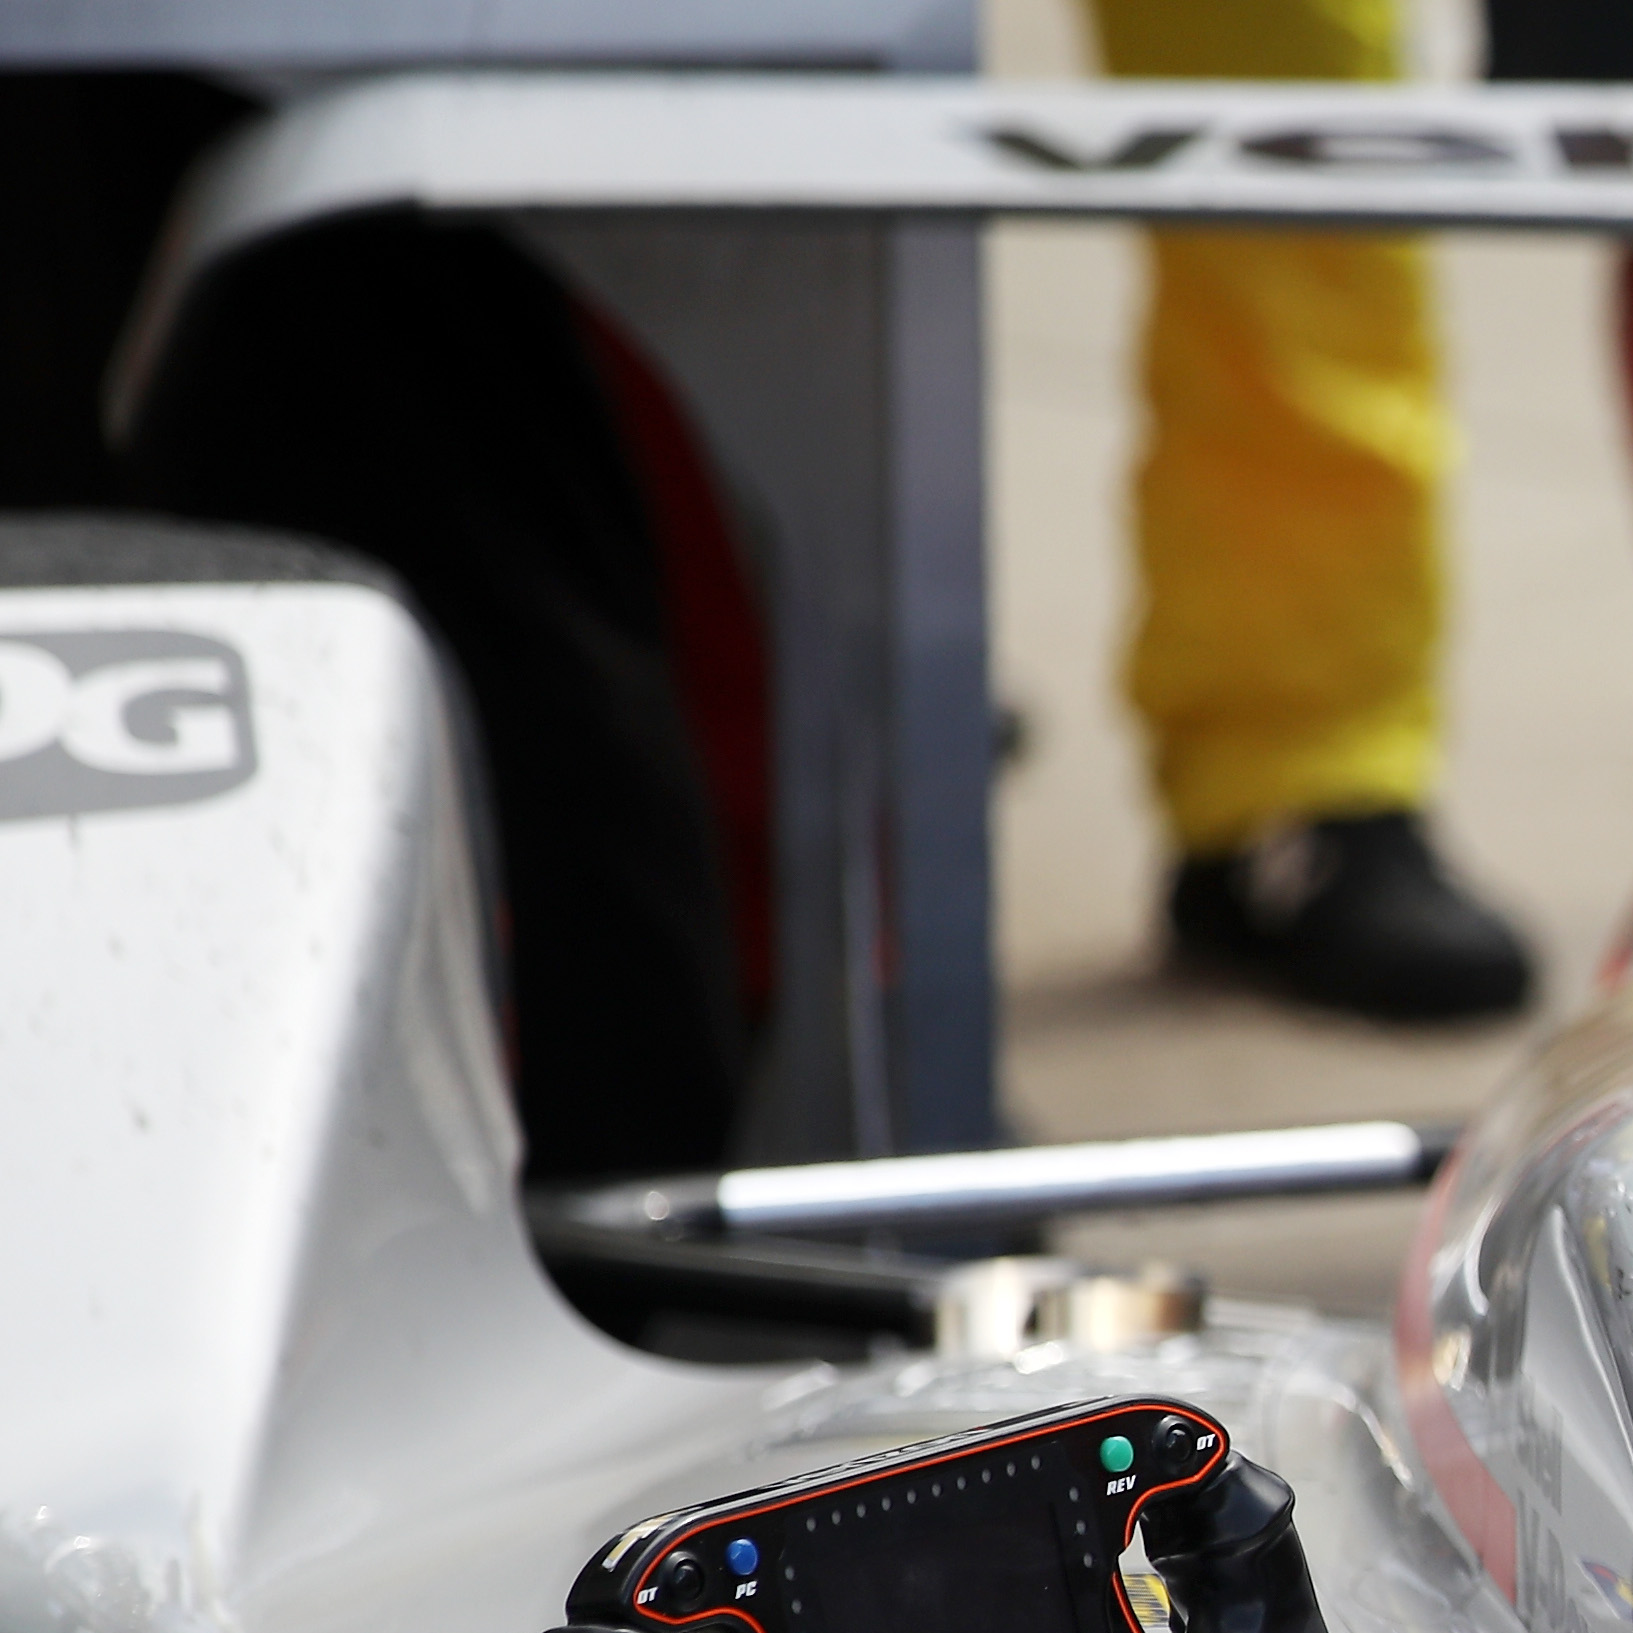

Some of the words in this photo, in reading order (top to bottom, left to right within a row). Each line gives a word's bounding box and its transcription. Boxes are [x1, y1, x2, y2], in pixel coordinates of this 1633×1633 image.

[1196, 1433, 1216, 1451] OT
[1106, 1474, 1137, 1496] REV
[637, 1586, 659, 1604] OT
[734, 1580, 758, 1600] PC
